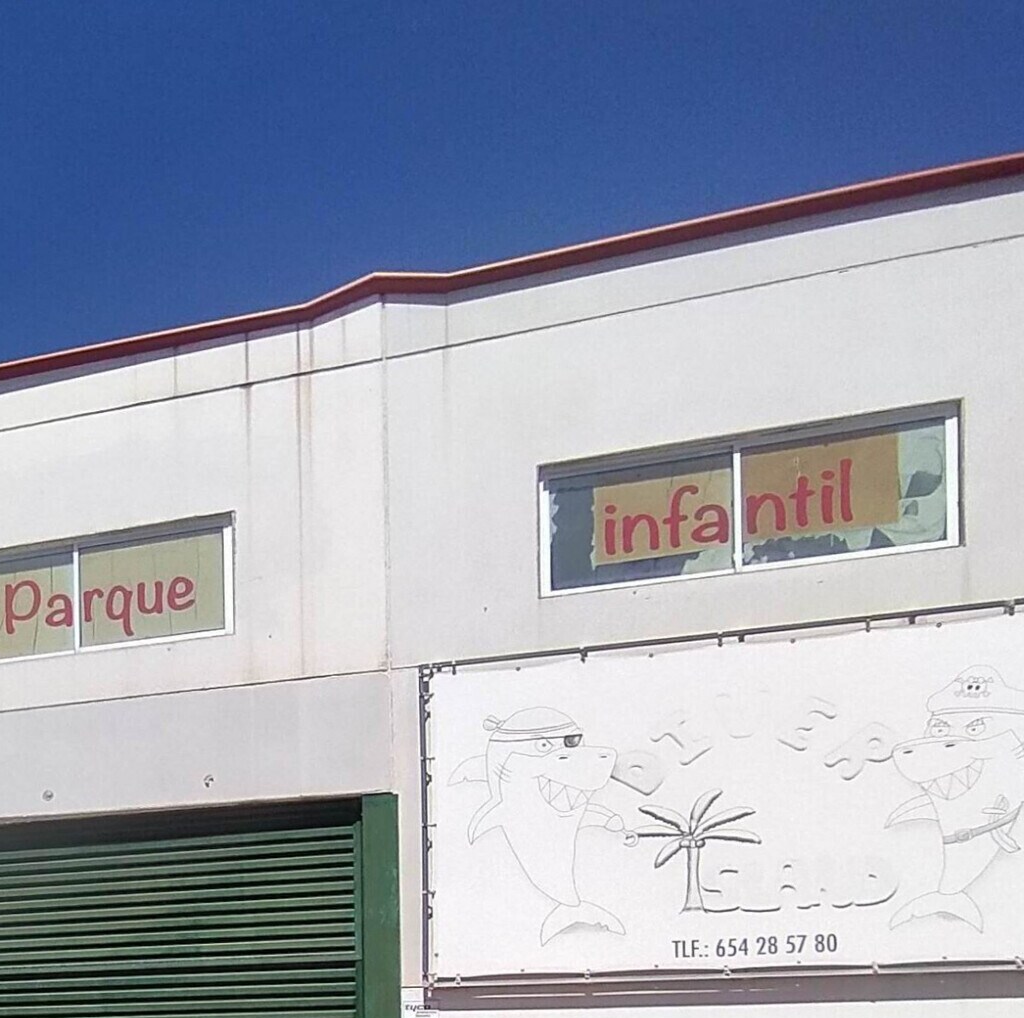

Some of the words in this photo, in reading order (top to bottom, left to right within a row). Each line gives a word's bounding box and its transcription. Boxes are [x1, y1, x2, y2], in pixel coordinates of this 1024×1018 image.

[4, 576, 196, 636] Parque
[603, 457, 854, 555] infantil
[672, 939, 709, 958] TLF.:
[715, 938, 749, 957] 654
[756, 936, 778, 955] 28
[785, 934, 807, 954] 57
[814, 933, 837, 953] 80
